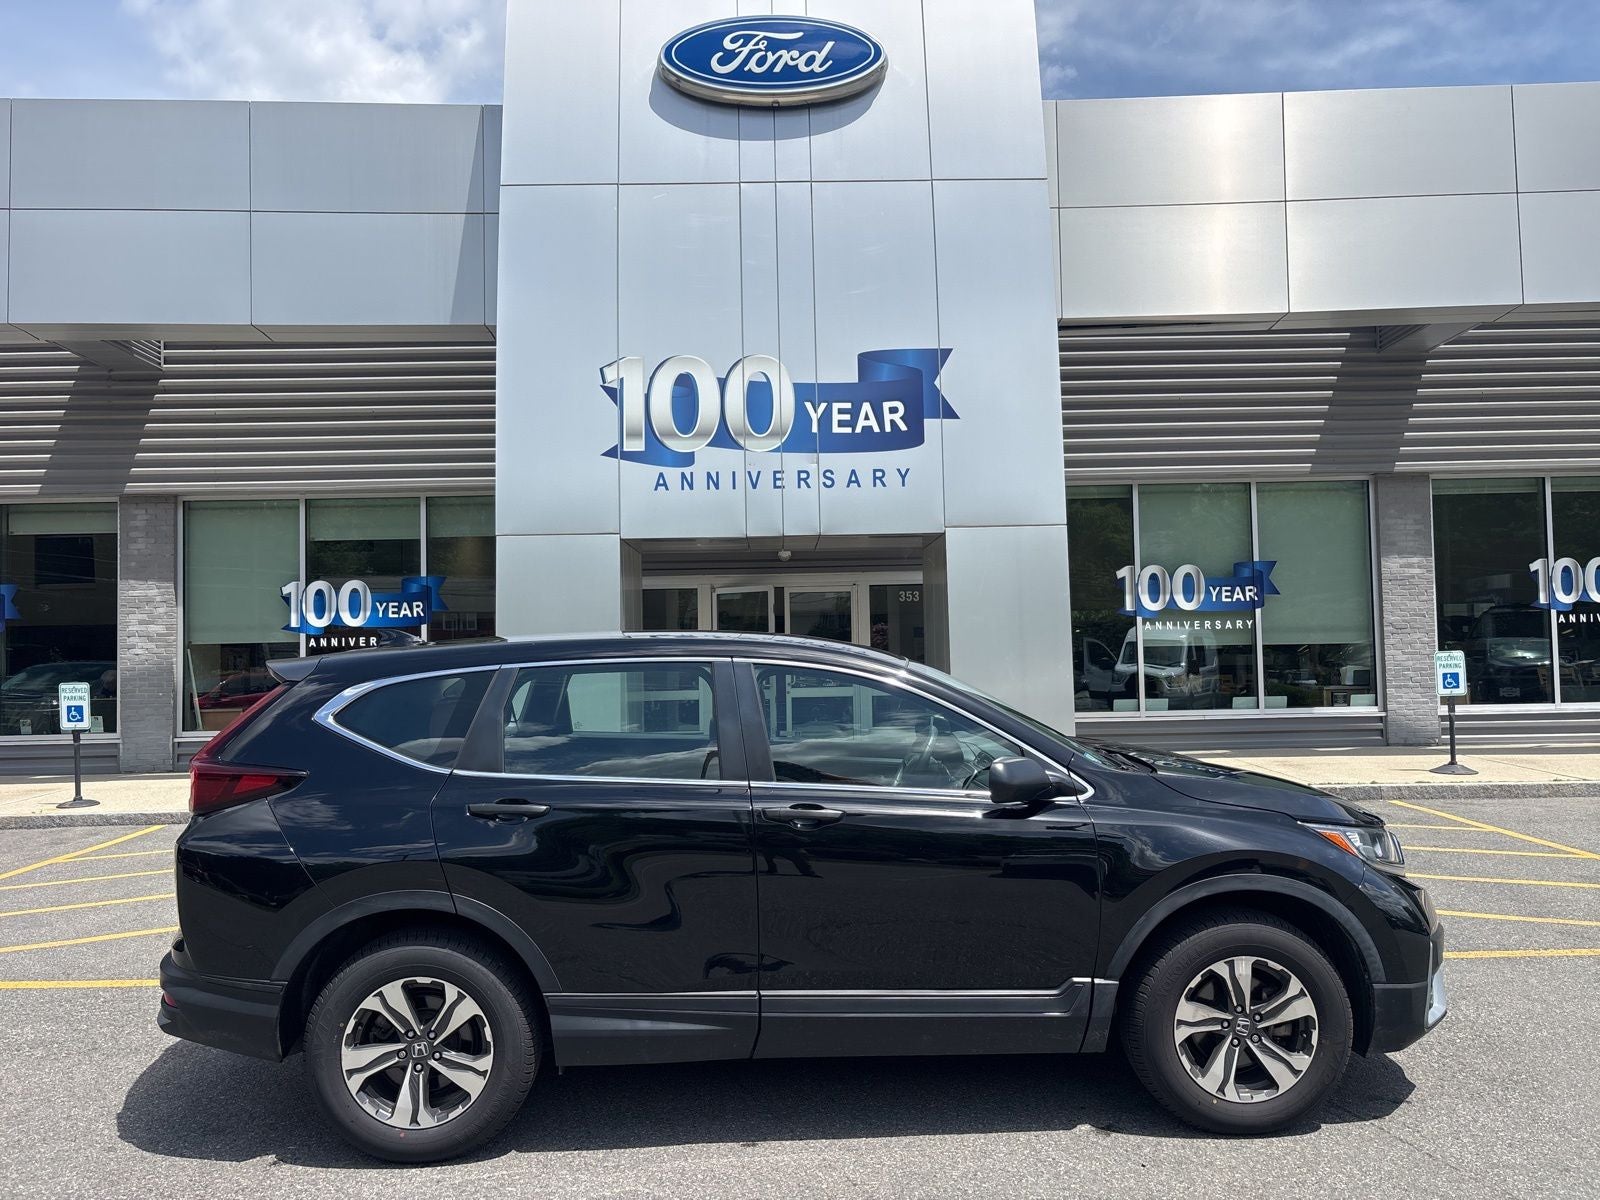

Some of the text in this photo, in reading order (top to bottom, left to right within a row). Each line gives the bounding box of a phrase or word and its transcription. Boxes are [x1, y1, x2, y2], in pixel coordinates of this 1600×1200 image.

[710, 30, 835, 74] Ford
[600, 354, 908, 453] 100 YEAR
[654, 467, 911, 492] ANNIVERSARY
[281, 579, 424, 628] 100 YEAR
[899, 591, 920, 602] 353
[1115, 564, 1258, 612] 100 YEAR
[1144, 619, 1253, 631] ANNIVERSARY
